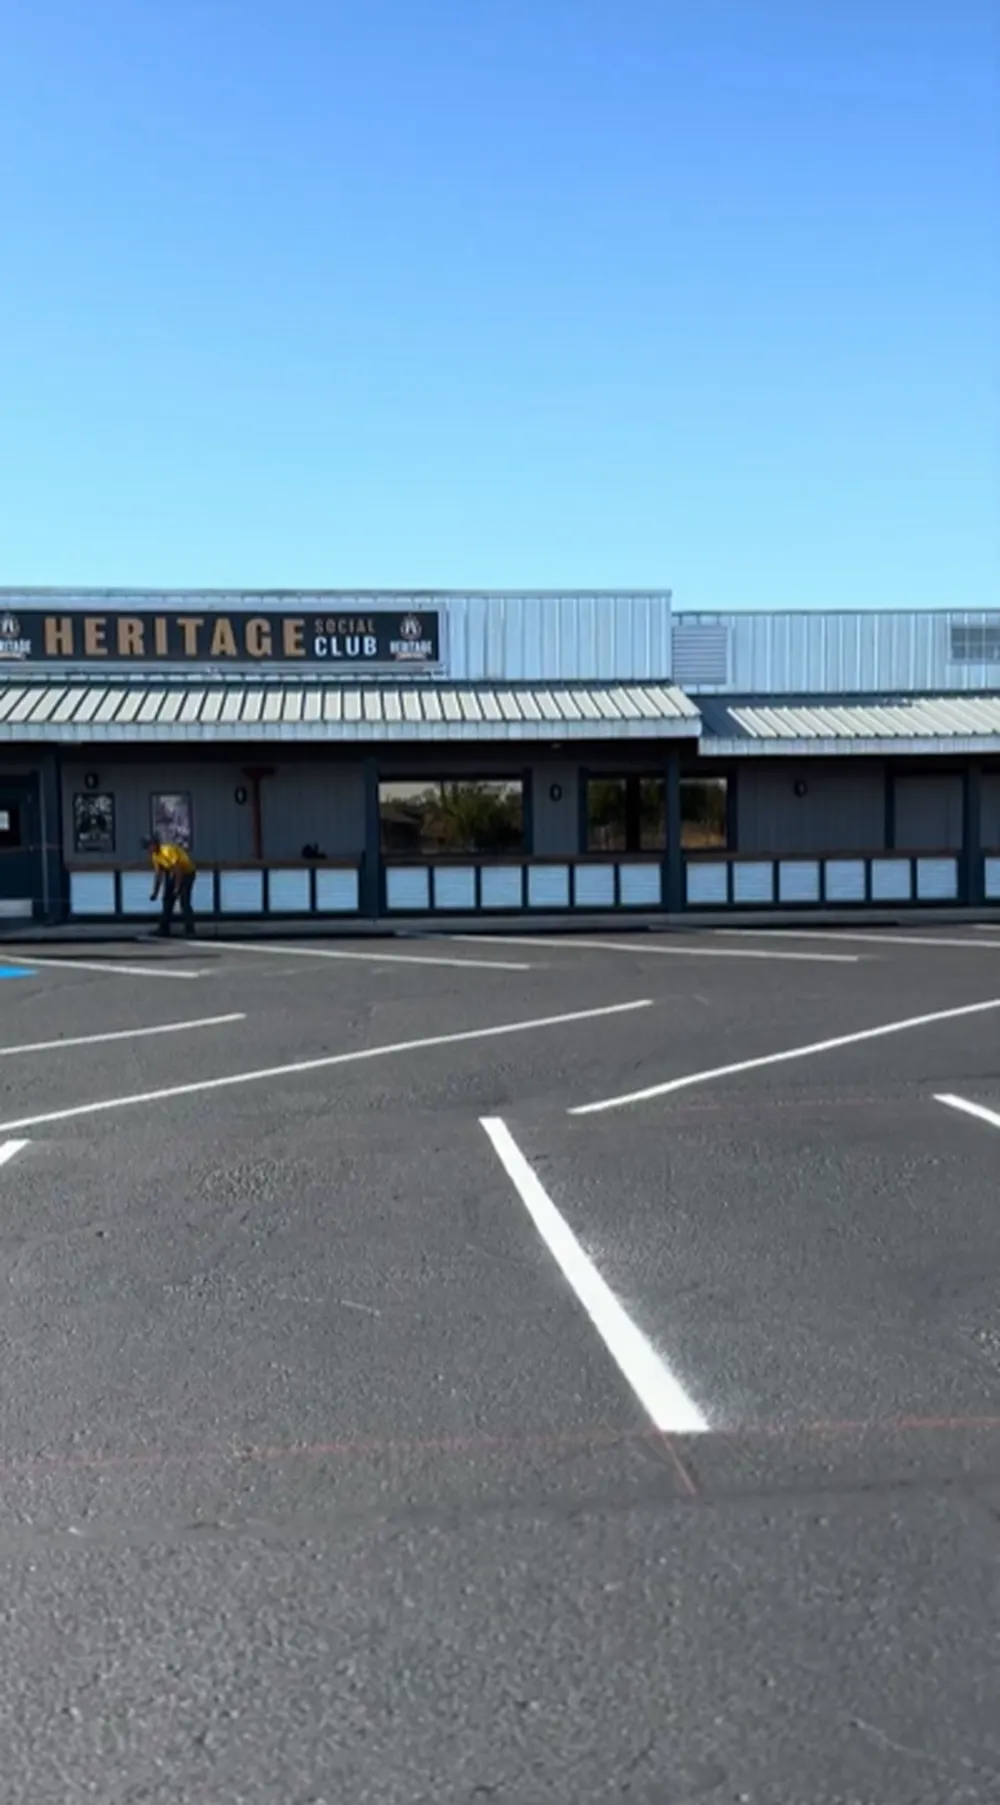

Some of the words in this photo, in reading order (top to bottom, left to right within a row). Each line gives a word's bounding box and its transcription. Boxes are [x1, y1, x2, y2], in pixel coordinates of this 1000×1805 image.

[44, 616, 306, 657] HERITAGE
[314, 618, 375, 634] SOCIAL
[314, 636, 377, 657] CLUB
